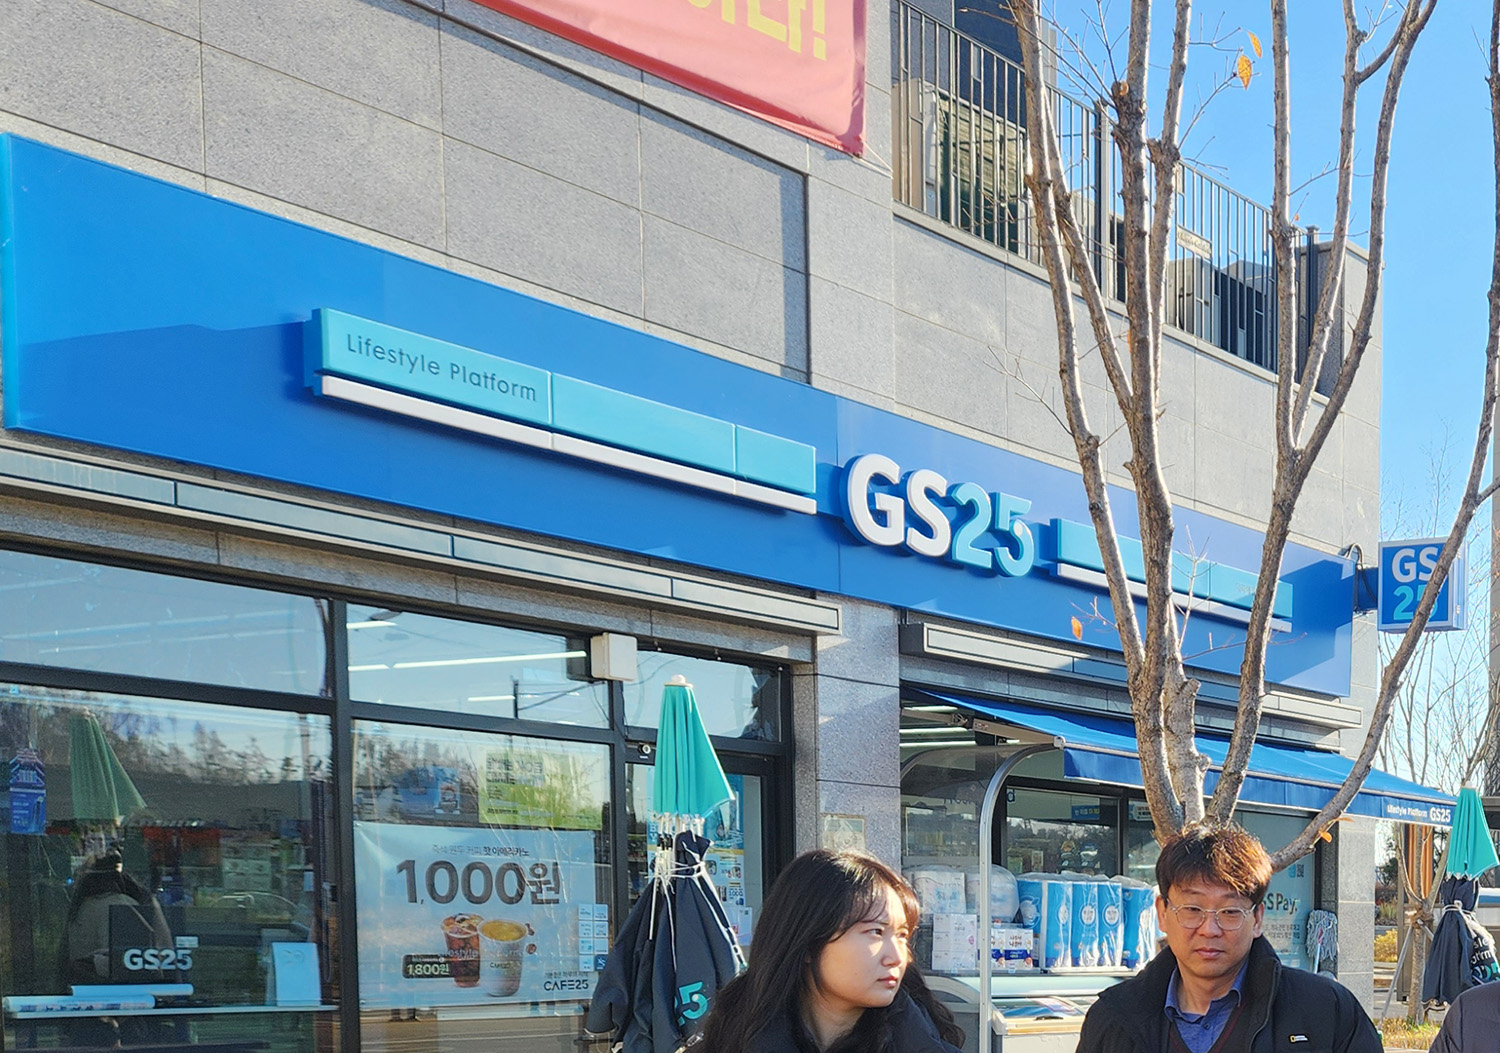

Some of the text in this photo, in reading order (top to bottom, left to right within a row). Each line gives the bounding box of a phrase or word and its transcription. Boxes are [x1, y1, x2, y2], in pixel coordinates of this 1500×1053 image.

[347, 334, 536, 400] Lifestyle Platform
[847, 453, 1034, 577] GS25
[1392, 547, 1439, 583] GS
[1429, 807, 1451, 823] GS25
[396, 860, 561, 905] 1,000원
[124, 949, 193, 971] GS25
[543, 979, 589, 991] CAFE25
